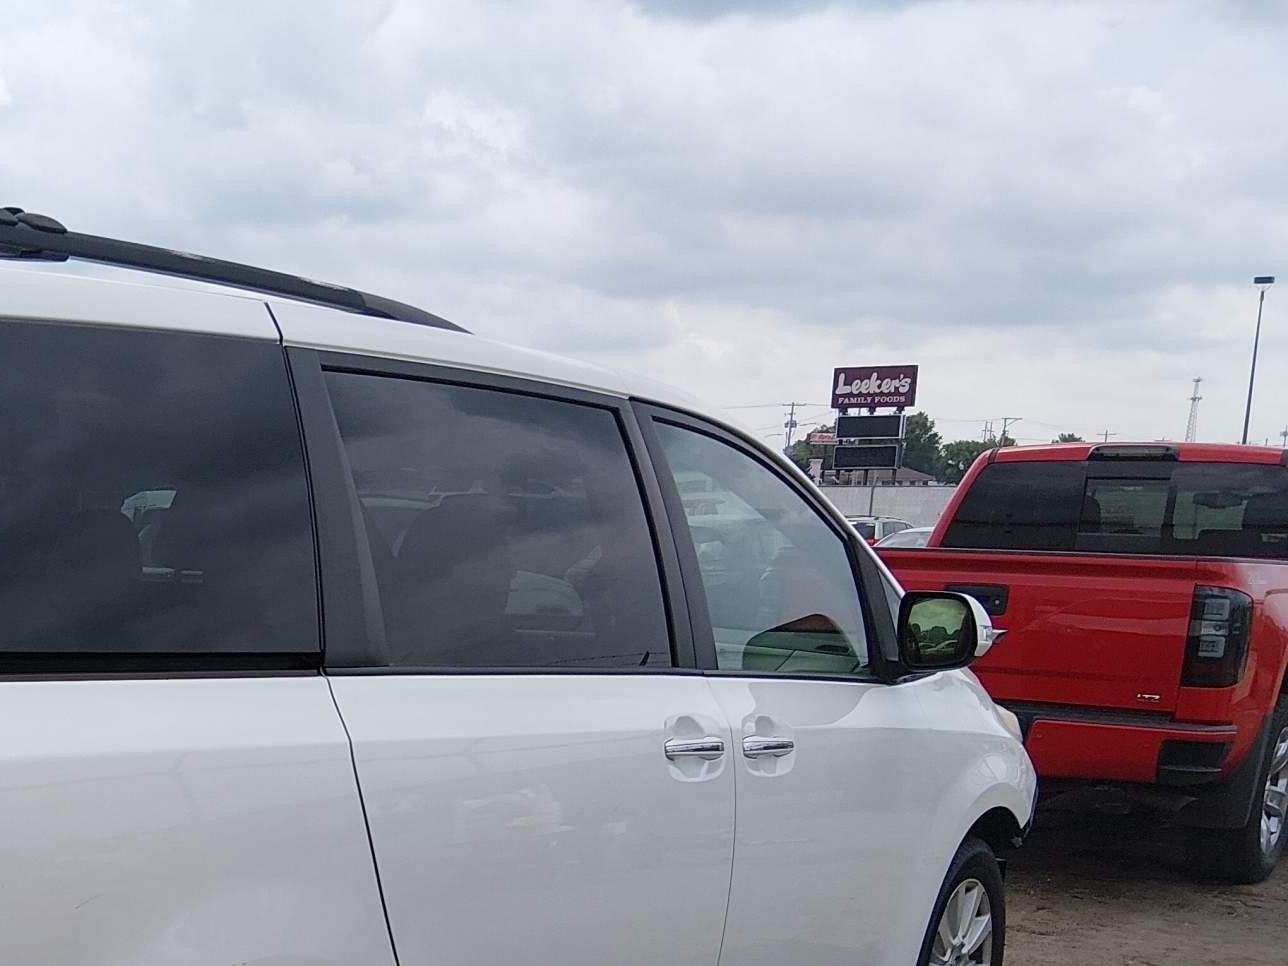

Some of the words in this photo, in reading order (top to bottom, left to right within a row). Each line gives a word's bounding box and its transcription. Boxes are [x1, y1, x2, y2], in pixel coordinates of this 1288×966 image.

[835, 372, 911, 394] Leeker's
[838, 396, 872, 404] FAMILY
[874, 395, 905, 403] FOODS
